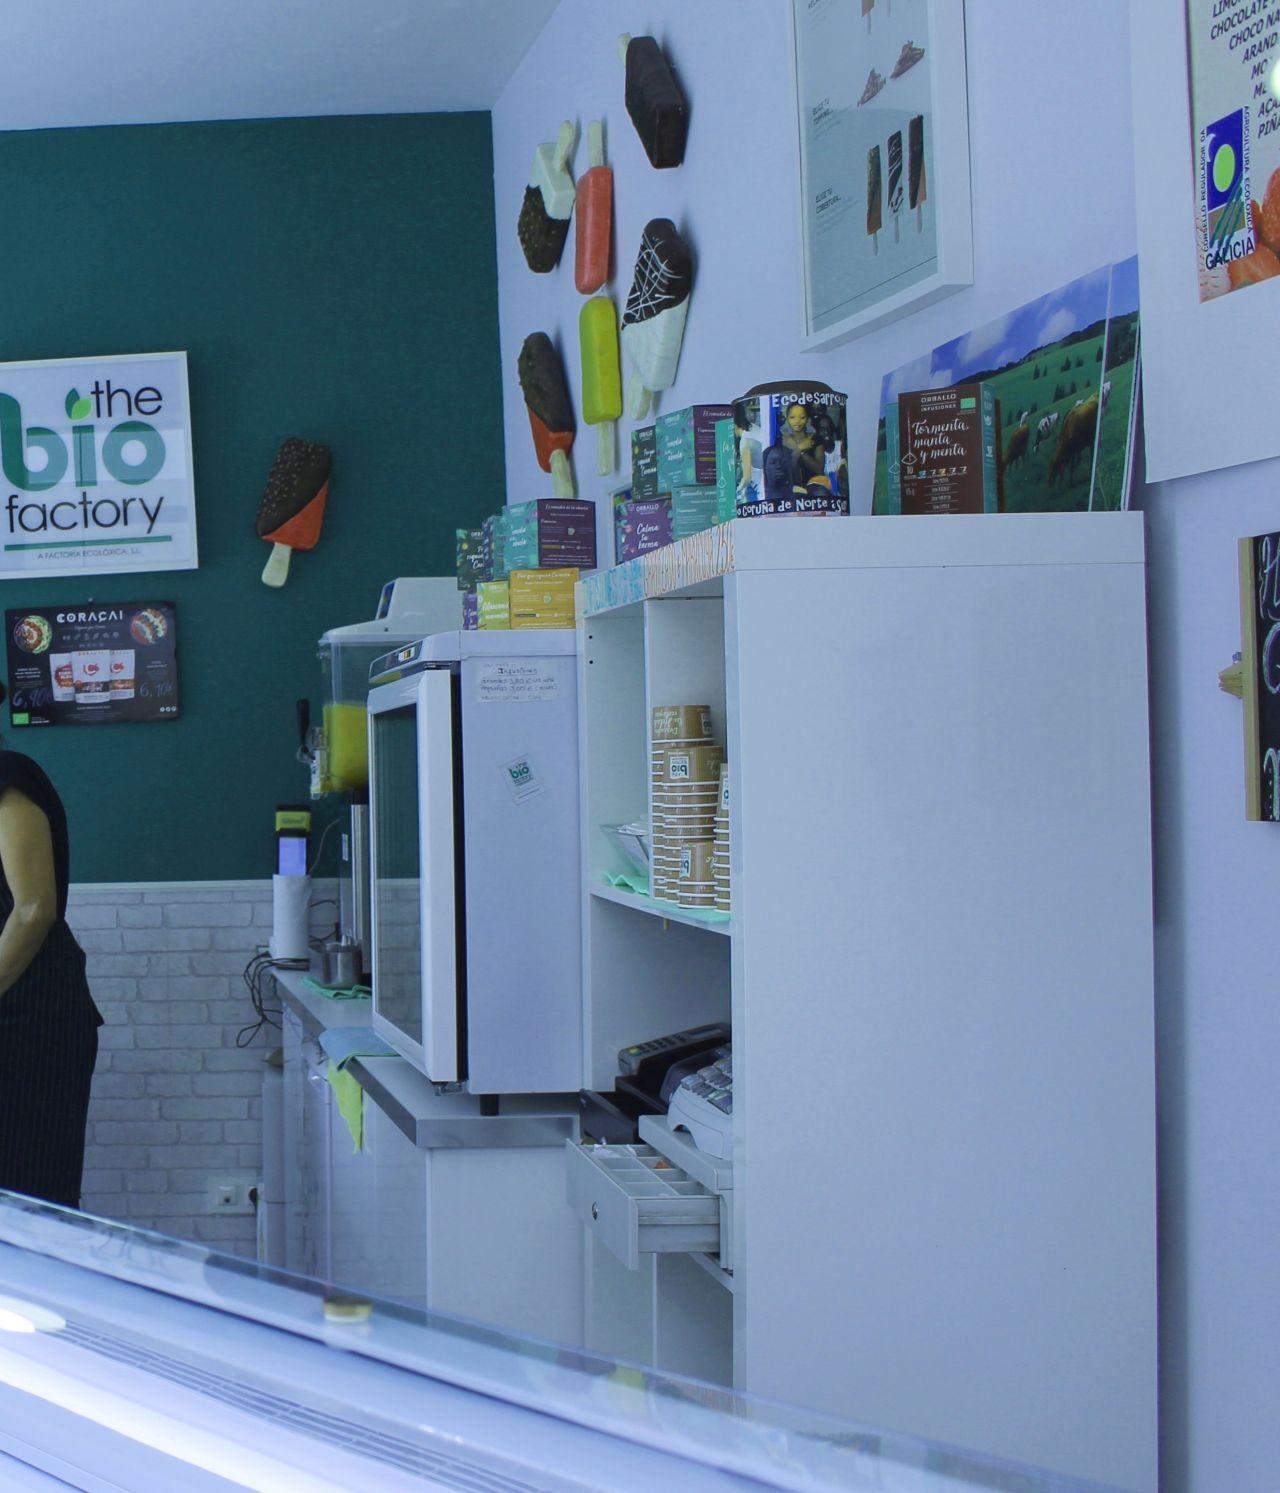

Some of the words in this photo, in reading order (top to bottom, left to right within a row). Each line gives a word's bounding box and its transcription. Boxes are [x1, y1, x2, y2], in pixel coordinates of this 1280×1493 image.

[1229, 18, 1264, 50] CHOCO
[1205, 237, 1255, 270] GALICIA
[91, 380, 162, 418] the
[921, 393, 956, 404] ORBALLO
[914, 432, 951, 449] manta
[920, 449, 928, 465] y
[930, 443, 967, 460] menta
[5, 491, 163, 533] factory
[742, 501, 774, 517] Coruña
[778, 499, 792, 512] de
[795, 498, 828, 512] Norte
[637, 523, 659, 535] Calma
[638, 540, 659, 550] karma
[57, 610, 124, 624] CORAÇAI
[508, 765, 529, 779] bio
[671, 764, 688, 776] bio
